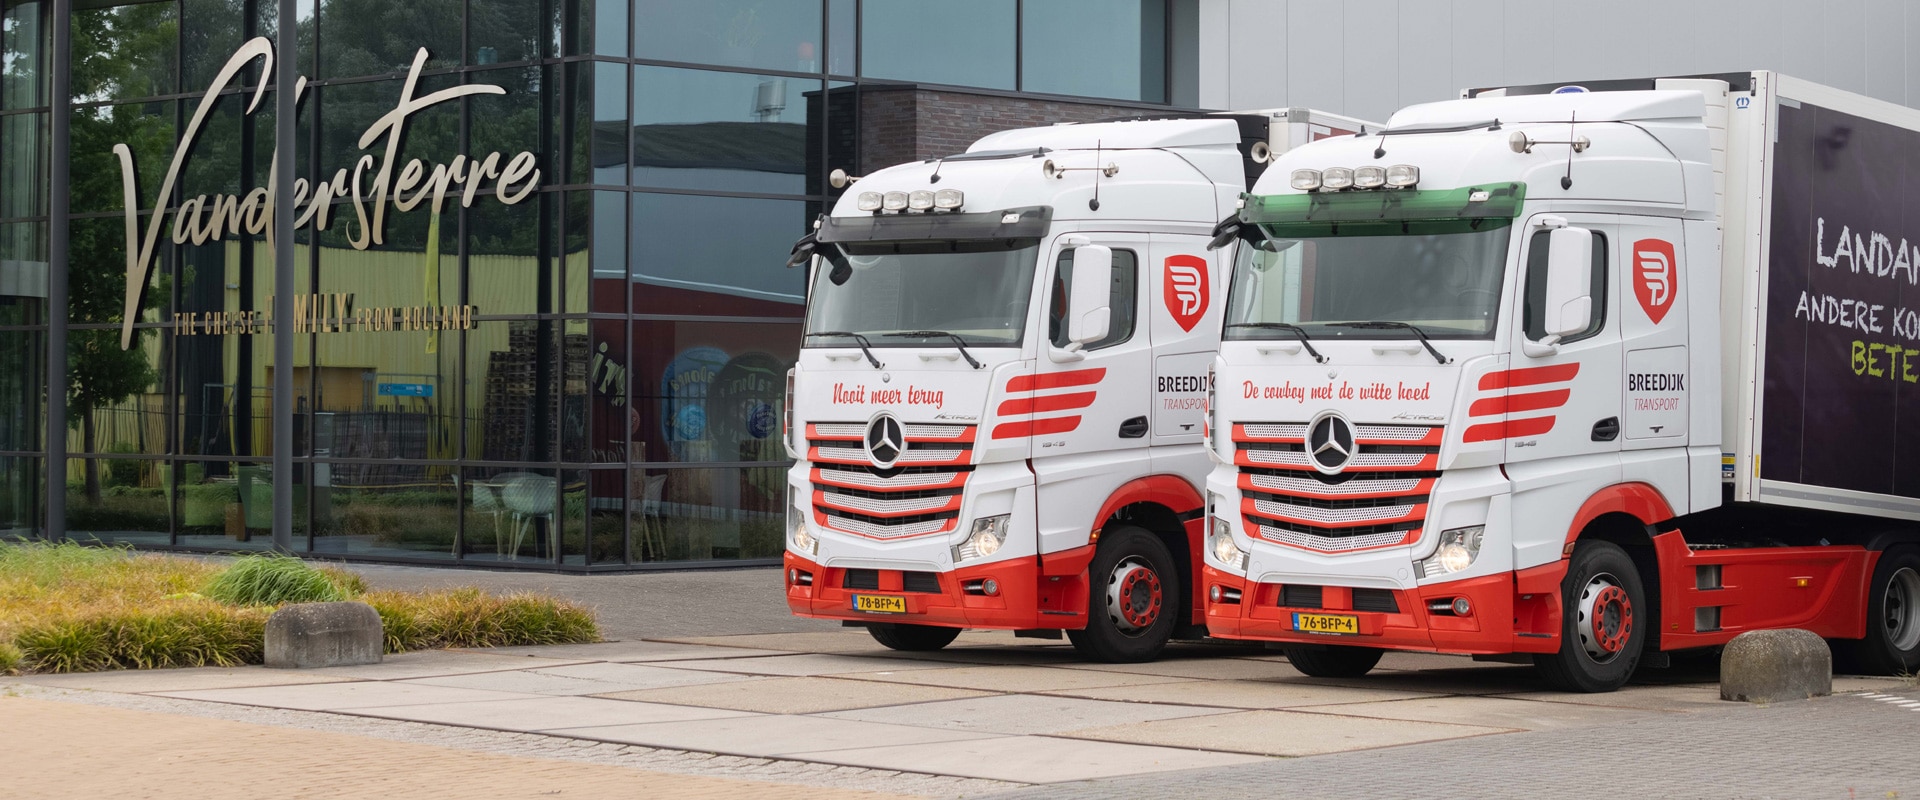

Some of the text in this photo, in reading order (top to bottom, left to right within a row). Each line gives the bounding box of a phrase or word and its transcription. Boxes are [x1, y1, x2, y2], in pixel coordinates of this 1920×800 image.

[174, 293, 471, 336] THE CHEESE FMILY FROM HOLLAND
[1795, 290, 1920, 341] ANDERE KO
[1243, 380, 1430, 404] De cowboy met de witte hoed
[1628, 373, 1685, 392] BREEDIJK
[833, 382, 944, 410] Nooit meer terug
[1163, 397, 1207, 411] TRANSPOR
[1634, 397, 1679, 411] TRANSPORT
[859, 596, 902, 610] 78-BFP-4
[1302, 616, 1353, 631] 76-BFP-4
